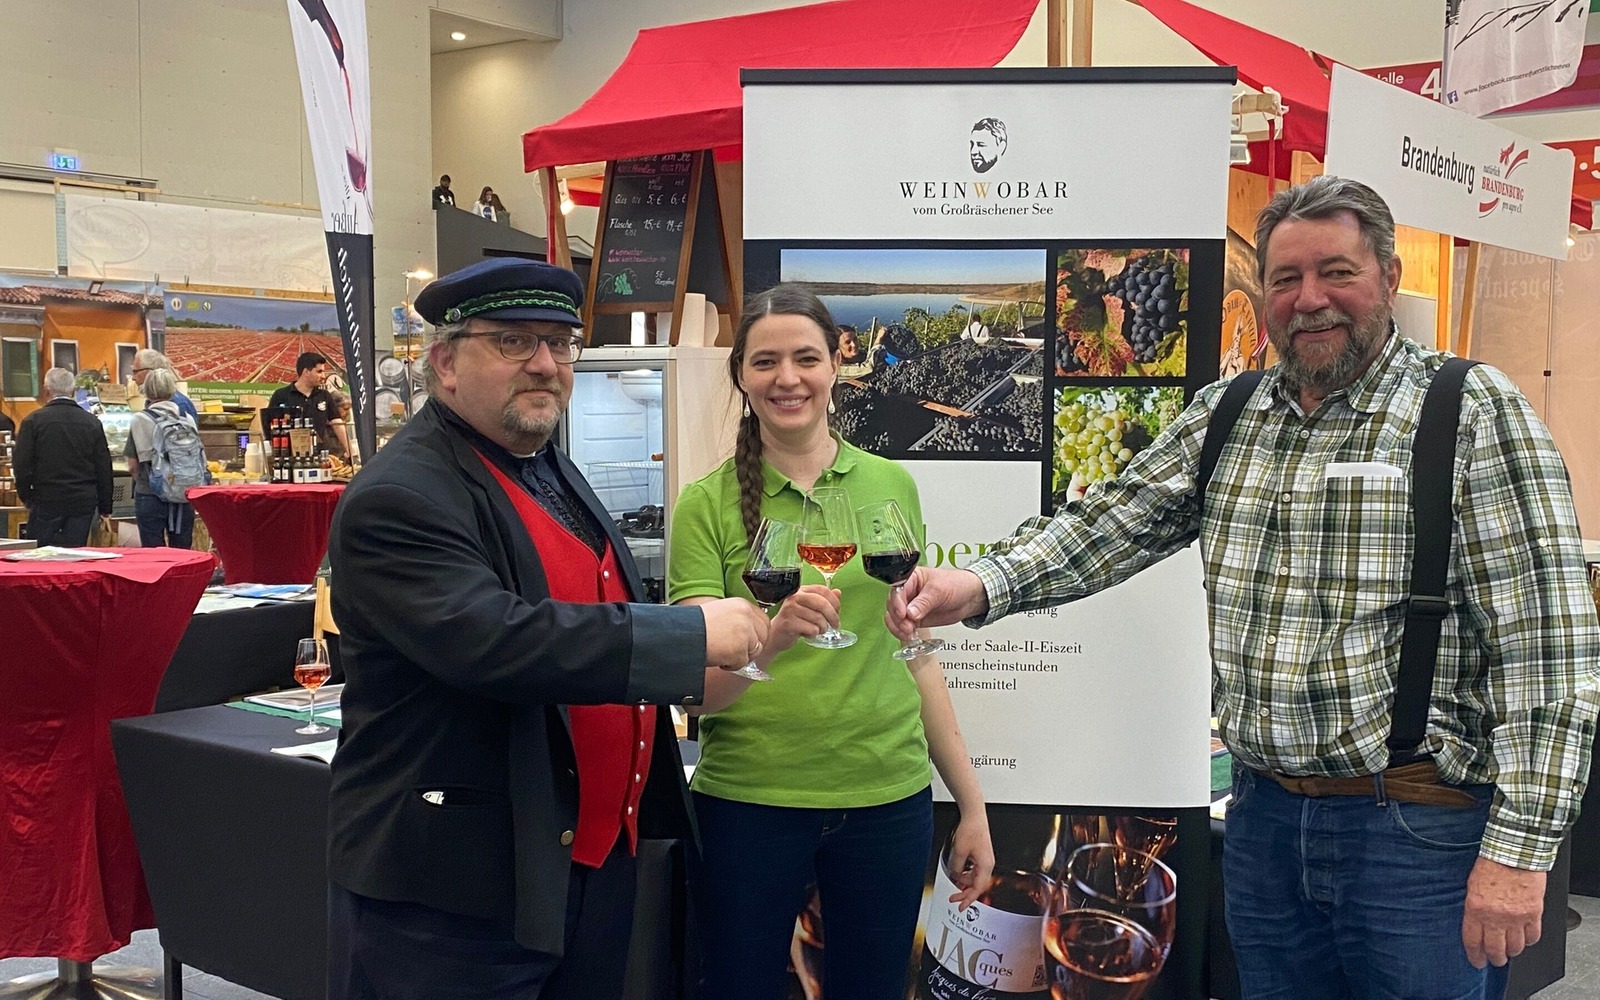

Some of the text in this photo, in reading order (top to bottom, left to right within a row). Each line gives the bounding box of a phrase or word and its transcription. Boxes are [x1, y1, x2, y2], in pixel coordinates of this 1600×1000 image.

[1377, 67, 1442, 100] alle 4
[1402, 135, 1475, 195] Brandenburg
[899, 181, 1068, 199] WEINWOBAR
[1481, 175, 1525, 201] BRANDENBURG
[912, 203, 1054, 216] vom Großräschener See
[939, 639, 1082, 654] us der Saale-II-Eiszeit
[939, 659, 1058, 672] nnenscheinstunden
[945, 677, 1017, 690] ahresmittel
[970, 755, 1017, 770] ngärung
